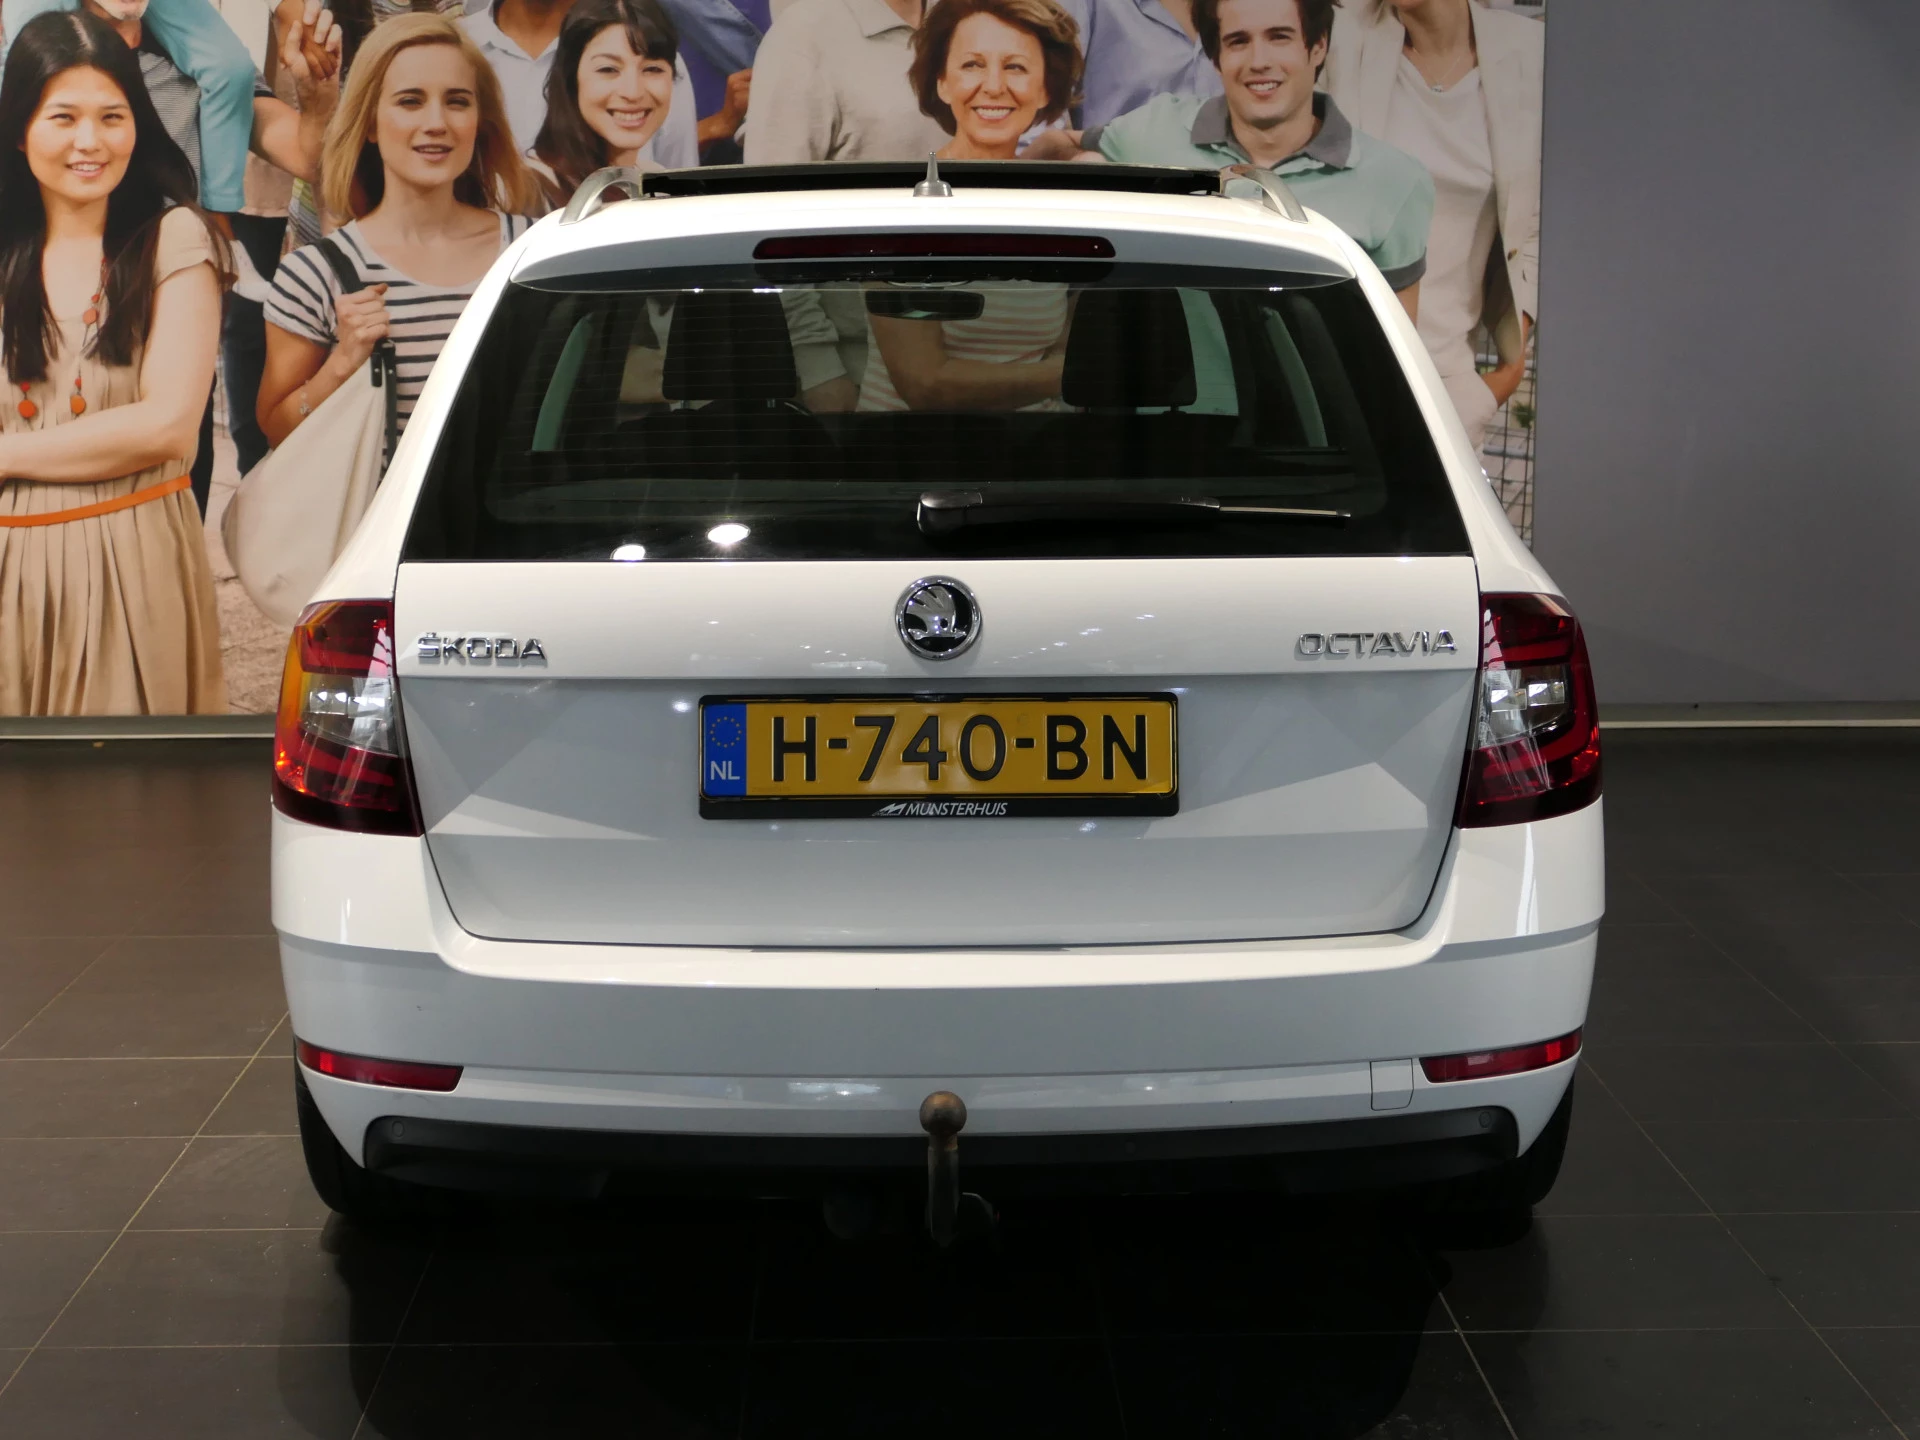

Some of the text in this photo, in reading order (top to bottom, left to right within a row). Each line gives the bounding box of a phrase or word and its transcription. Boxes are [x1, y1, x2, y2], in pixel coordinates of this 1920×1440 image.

[418, 632, 546, 660] ŠKODA
[1298, 630, 1457, 655] OCTAVIA
[772, 714, 1147, 782] H-740-BN
[710, 760, 740, 780] NL
[905, 802, 1008, 816] MUNSTERHUIS
